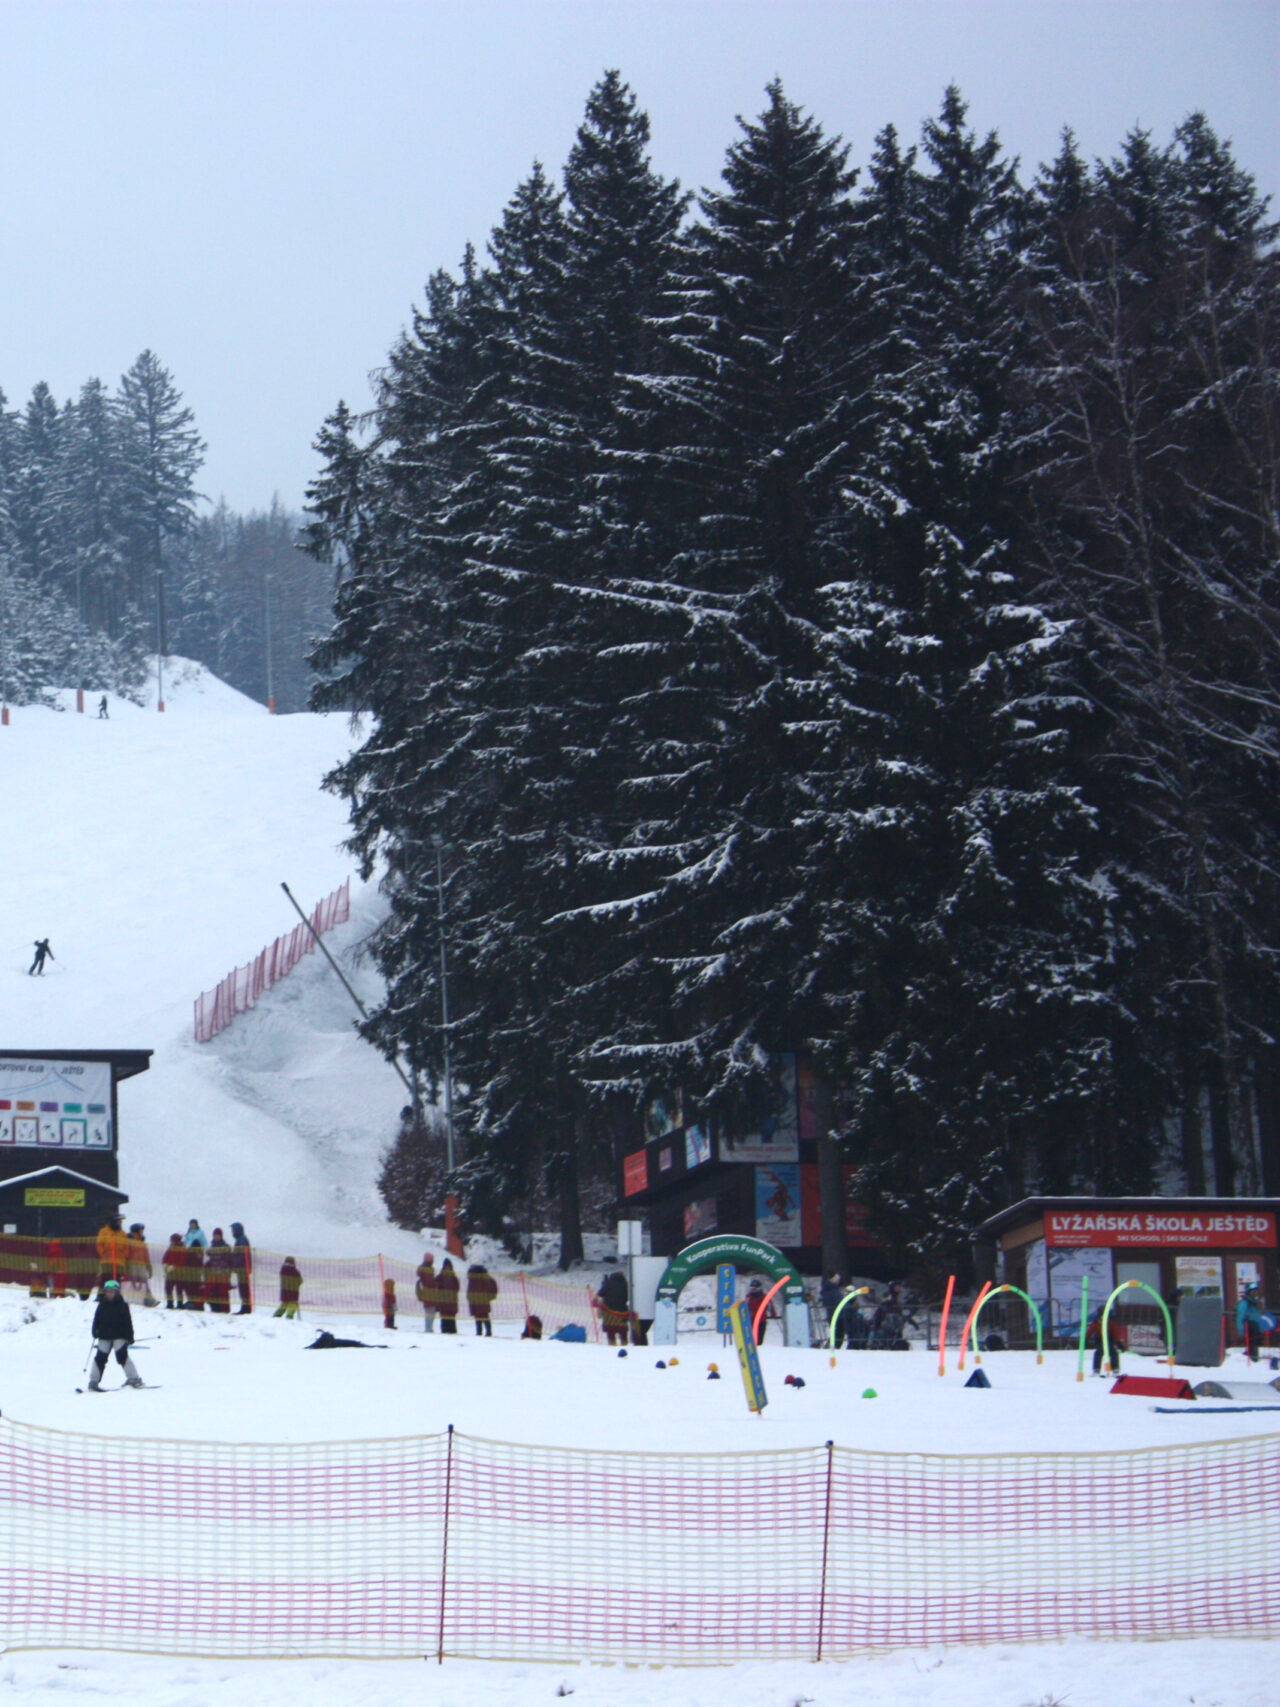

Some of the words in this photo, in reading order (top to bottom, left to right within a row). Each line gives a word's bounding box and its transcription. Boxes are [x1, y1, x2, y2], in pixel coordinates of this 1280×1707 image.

[1052, 1214, 1142, 1231] LYŽAŘSKÁ
[1145, 1214, 1203, 1231] ŠKOLA
[1206, 1215, 1269, 1231] JEŠTĚD
[685, 1243, 739, 1263] Kooperativa
[740, 1243, 777, 1265] FunPark
